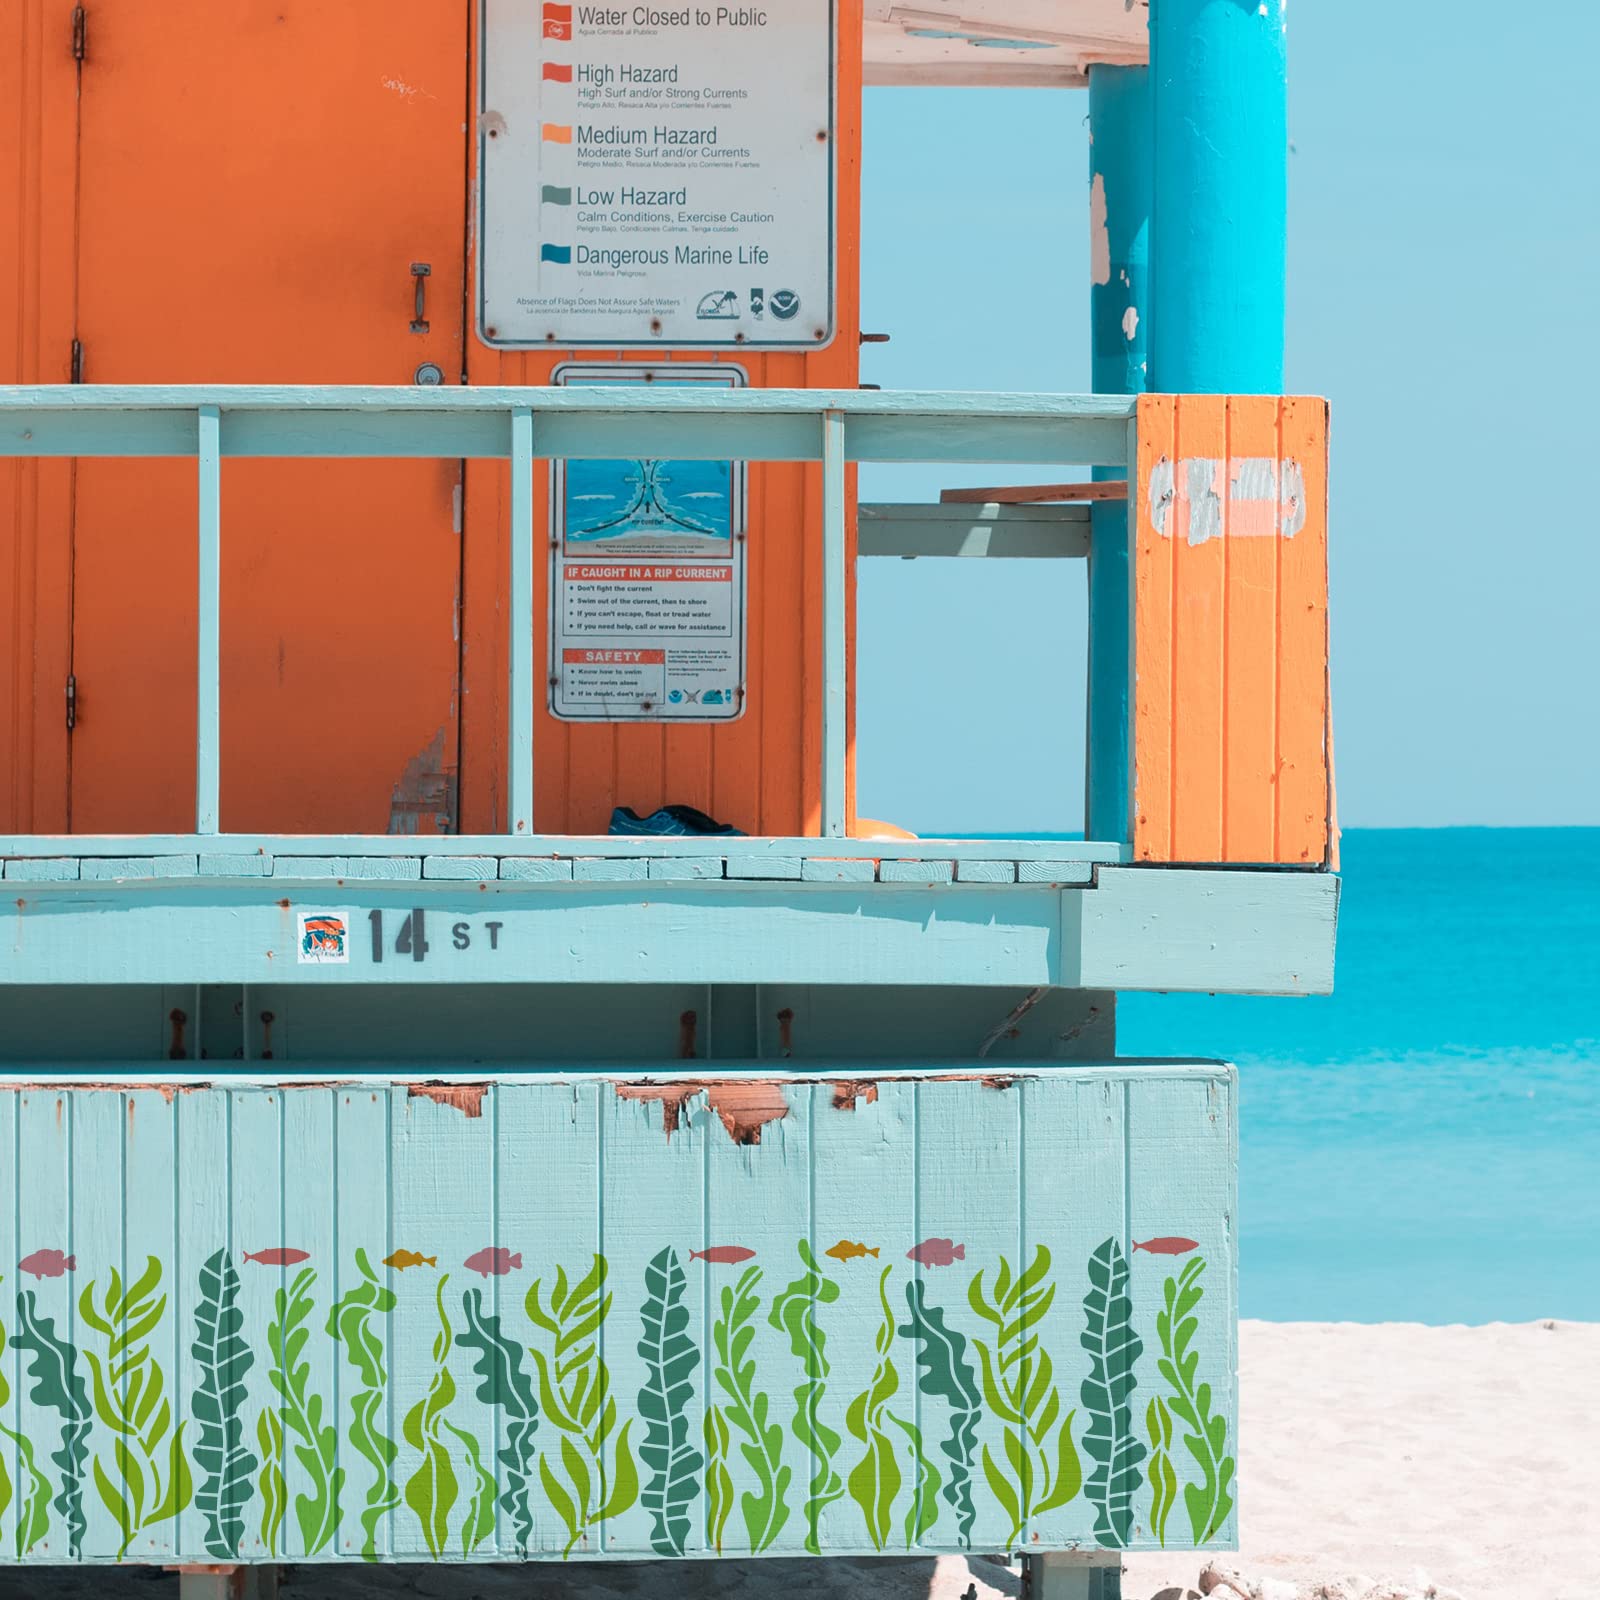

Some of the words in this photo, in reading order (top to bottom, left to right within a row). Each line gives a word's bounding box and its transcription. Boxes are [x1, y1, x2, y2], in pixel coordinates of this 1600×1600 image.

[578, 7, 627, 25] Water
[632, 7, 690, 25] Closed
[695, 9, 711, 26] to
[716, 7, 768, 26] Public
[577, 64, 614, 87] High
[620, 64, 678, 83] Hazard
[577, 88, 602, 100] High
[605, 88, 627, 98] Surf
[629, 88, 663, 98] and/or
[665, 88, 700, 101] Strong
[703, 88, 748, 98] Currents
[577, 126, 647, 144] Medium
[653, 126, 717, 144] Hazard
[577, 148, 631, 158] Moderate
[635, 148, 659, 158] Surf
[662, 148, 697, 158] and/or
[701, 148, 750, 158] Currents
[577, 187, 614, 205] Low
[621, 187, 687, 205] Hazard
[577, 212, 607, 223] Calm
[610, 212, 675, 225] Conditions,
[678, 212, 726, 223] Exercise
[729, 212, 774, 223] Caution
[577, 246, 668, 268] Dangerous
[675, 246, 732, 264] Marine
[738, 246, 769, 264] Life
[558, 298, 577, 307] Flags
[568, 568, 578, 576] IF
[581, 568, 626, 577] CAUGHT
[629, 568, 640, 577] IN
[643, 568, 652, 577] A
[654, 568, 673, 577] RIP
[675, 568, 727, 578] CURRENT
[596, 585, 612, 593] fight
[616, 623, 633, 631] help,
[585, 652, 641, 661] SAFETY
[368, 908, 429, 963] 14
[452, 922, 503, 950] ST
